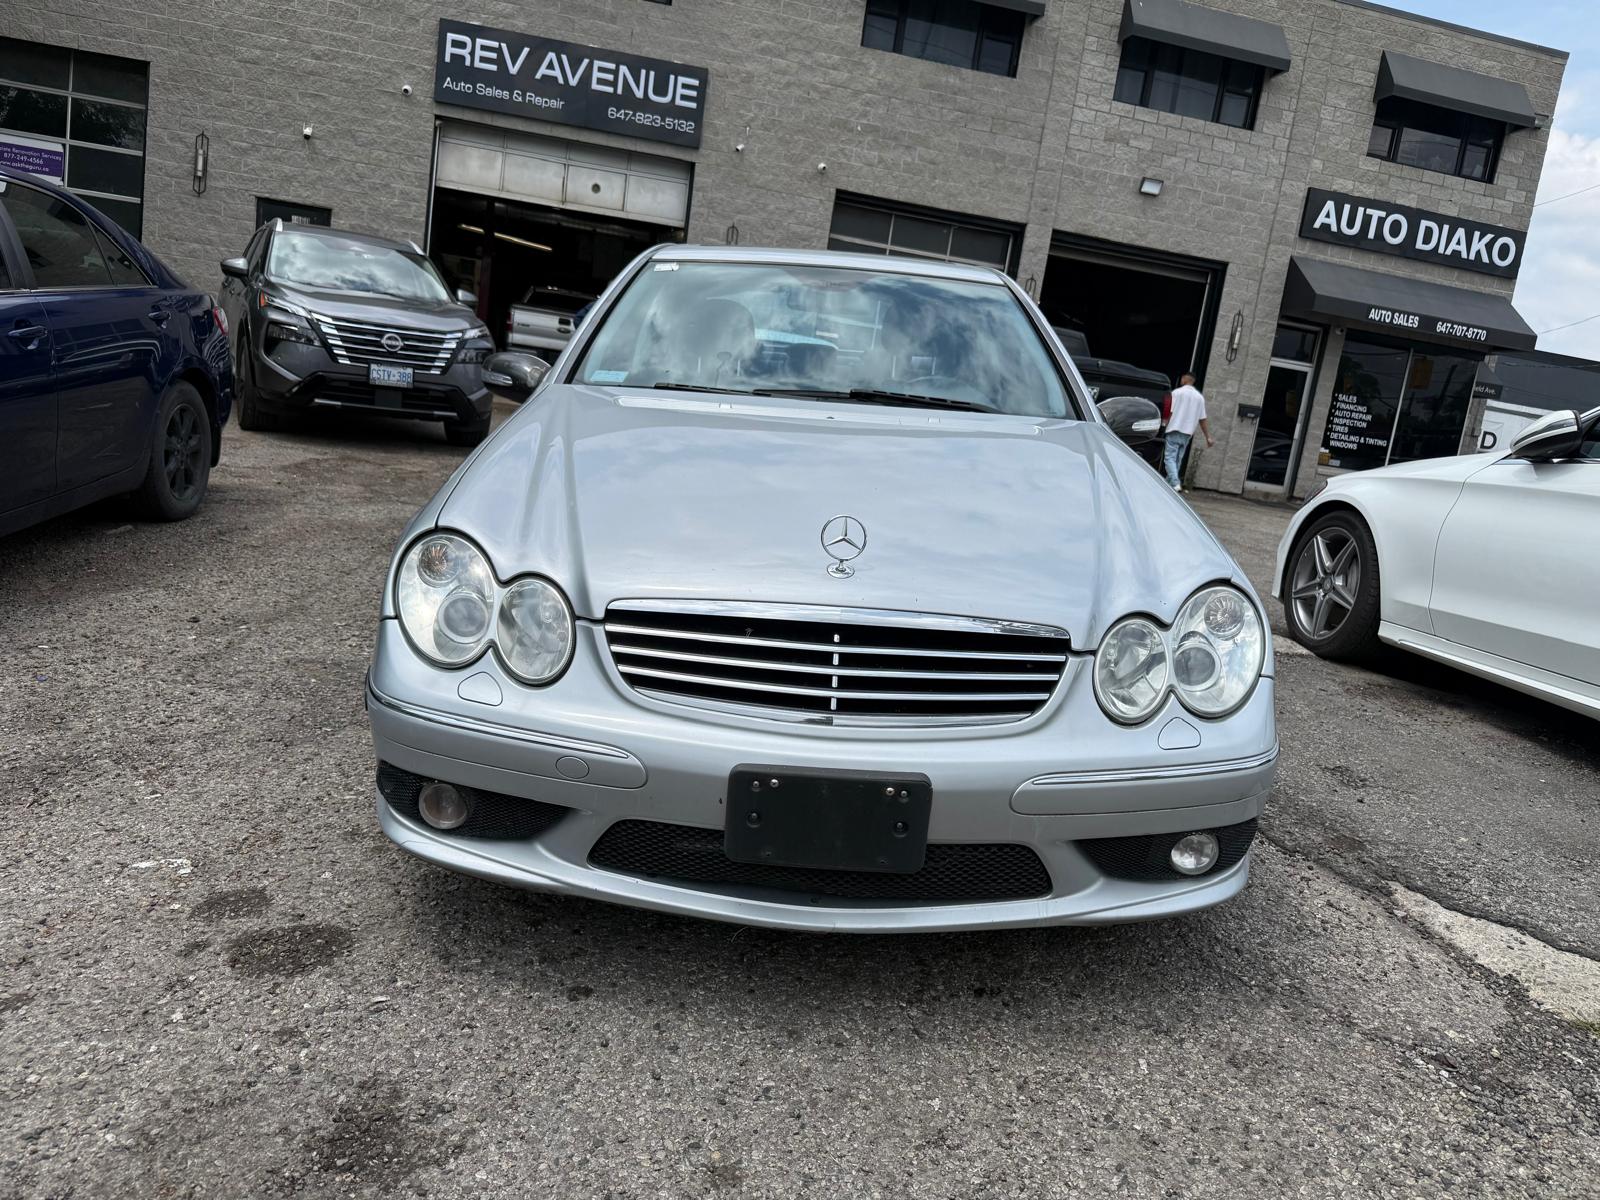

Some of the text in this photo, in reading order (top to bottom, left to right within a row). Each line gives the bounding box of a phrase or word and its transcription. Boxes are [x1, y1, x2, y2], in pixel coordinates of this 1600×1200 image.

[444, 32, 700, 109] REV AVENUE
[442, 76, 566, 110] Auto Sales & Repair
[607, 107, 695, 133] 647-823-5132
[41, 152, 62, 161] Services
[1312, 200, 1517, 267] AUTO DIAKO
[1368, 308, 1487, 341] AUTO SALES 647-707-8770
[1338, 393, 1357, 403] SALES
[1336, 402, 1367, 413] FINANCING
[1334, 409, 1373, 421] AUTO REPAIR
[1332, 424, 1349, 433] TIRES
[1333, 417, 1367, 428] INSPECTION
[1329, 440, 1358, 450] WINDOWS
[1330, 432, 1359, 443] DETAILING
[1365, 437, 1388, 447] TINTING
